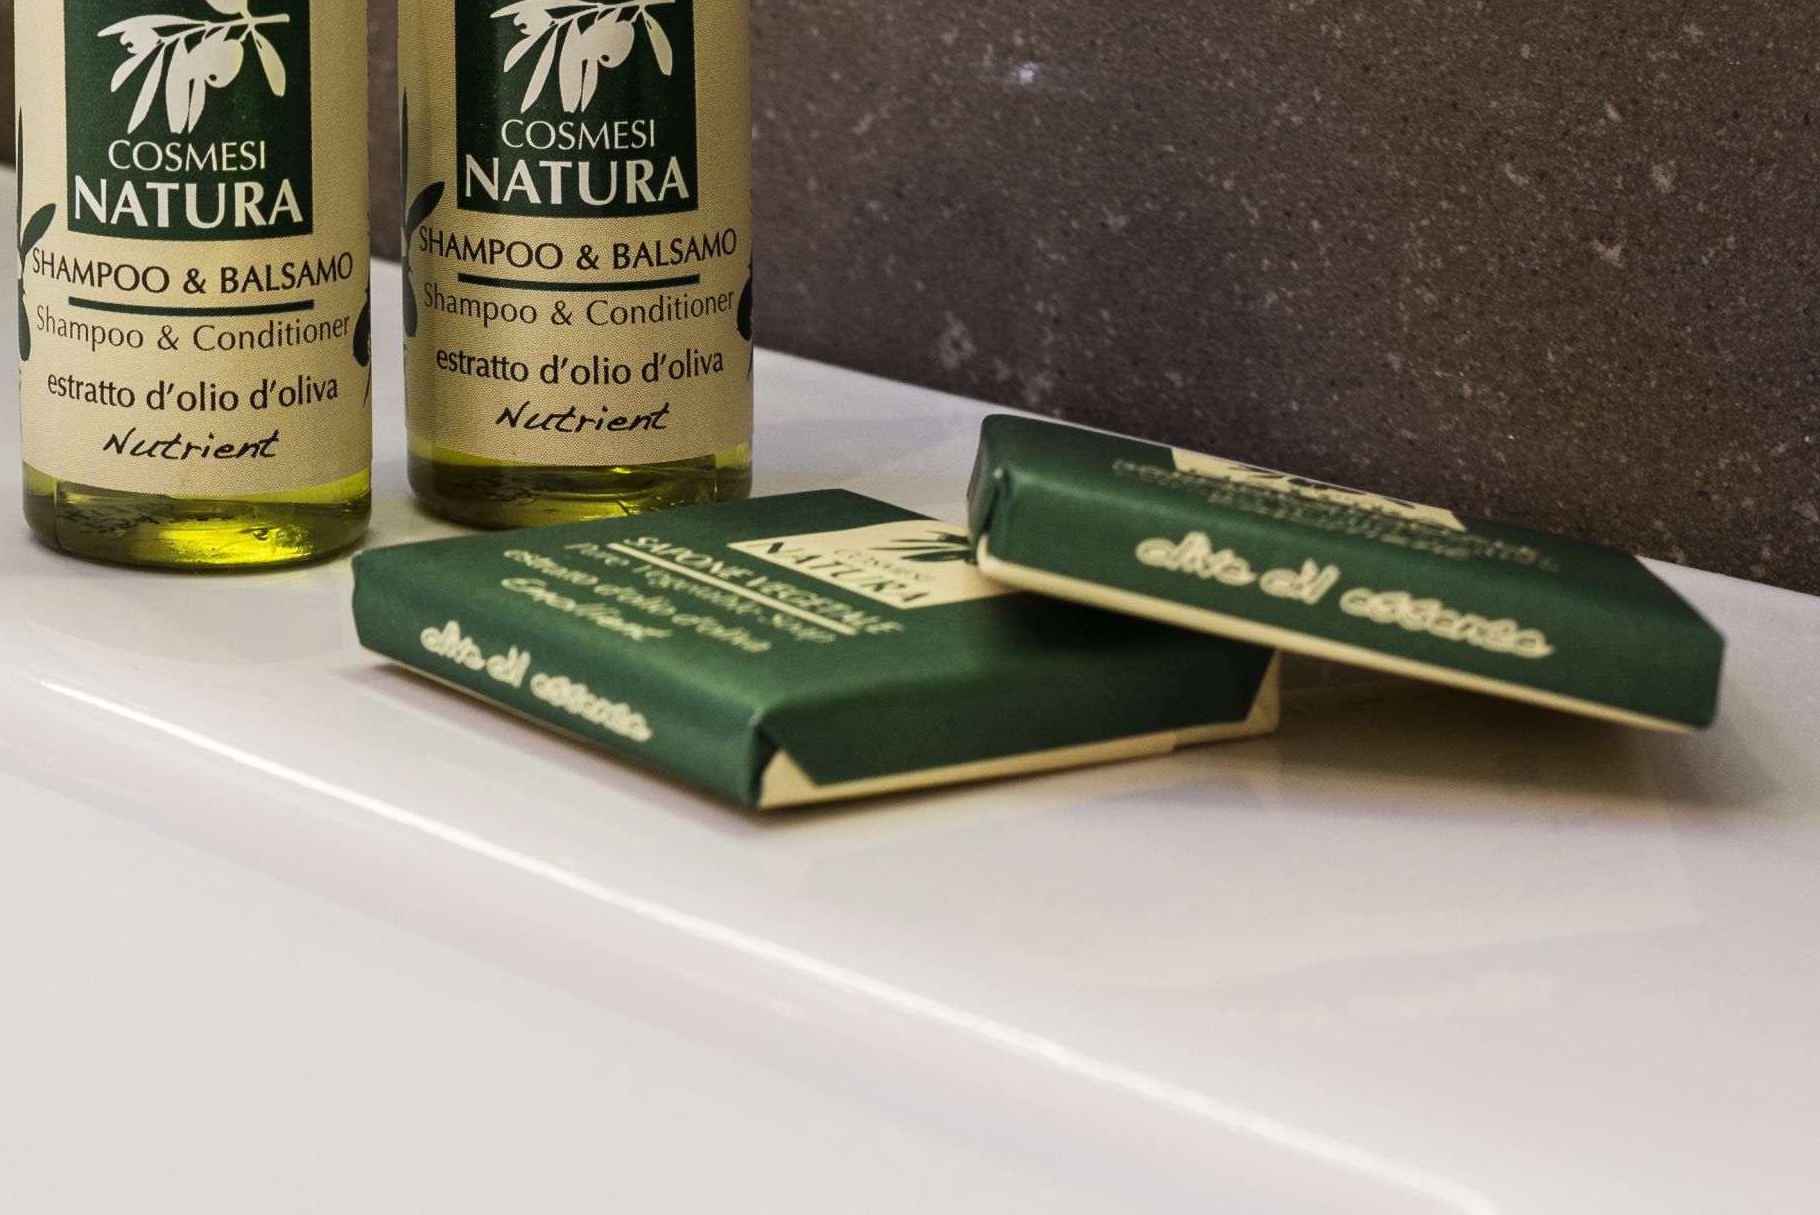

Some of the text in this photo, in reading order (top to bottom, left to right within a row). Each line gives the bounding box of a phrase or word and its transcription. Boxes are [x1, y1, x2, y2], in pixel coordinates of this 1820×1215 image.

[108, 140, 266, 172] COSMESI
[501, 119, 656, 150] COSMESI
[74, 175, 304, 229] NATURA
[465, 154, 689, 206] NATURA
[420, 225, 737, 270] SHAMPOO & BALSAMO
[32, 247, 353, 294] SHAMPOO & BALSAMO
[424, 282, 734, 328] Shampoo & Conditioner
[37, 305, 351, 351] Shampoo & Conditioner
[436, 348, 723, 386] estratto d'olio d'oliva
[48, 373, 338, 411] estratto d'olio d'oliva
[495, 401, 670, 433] Nutrient
[103, 427, 280, 461] Nutrient
[623, 536, 754, 579] SAPONE
[746, 541, 930, 604] NATURA
